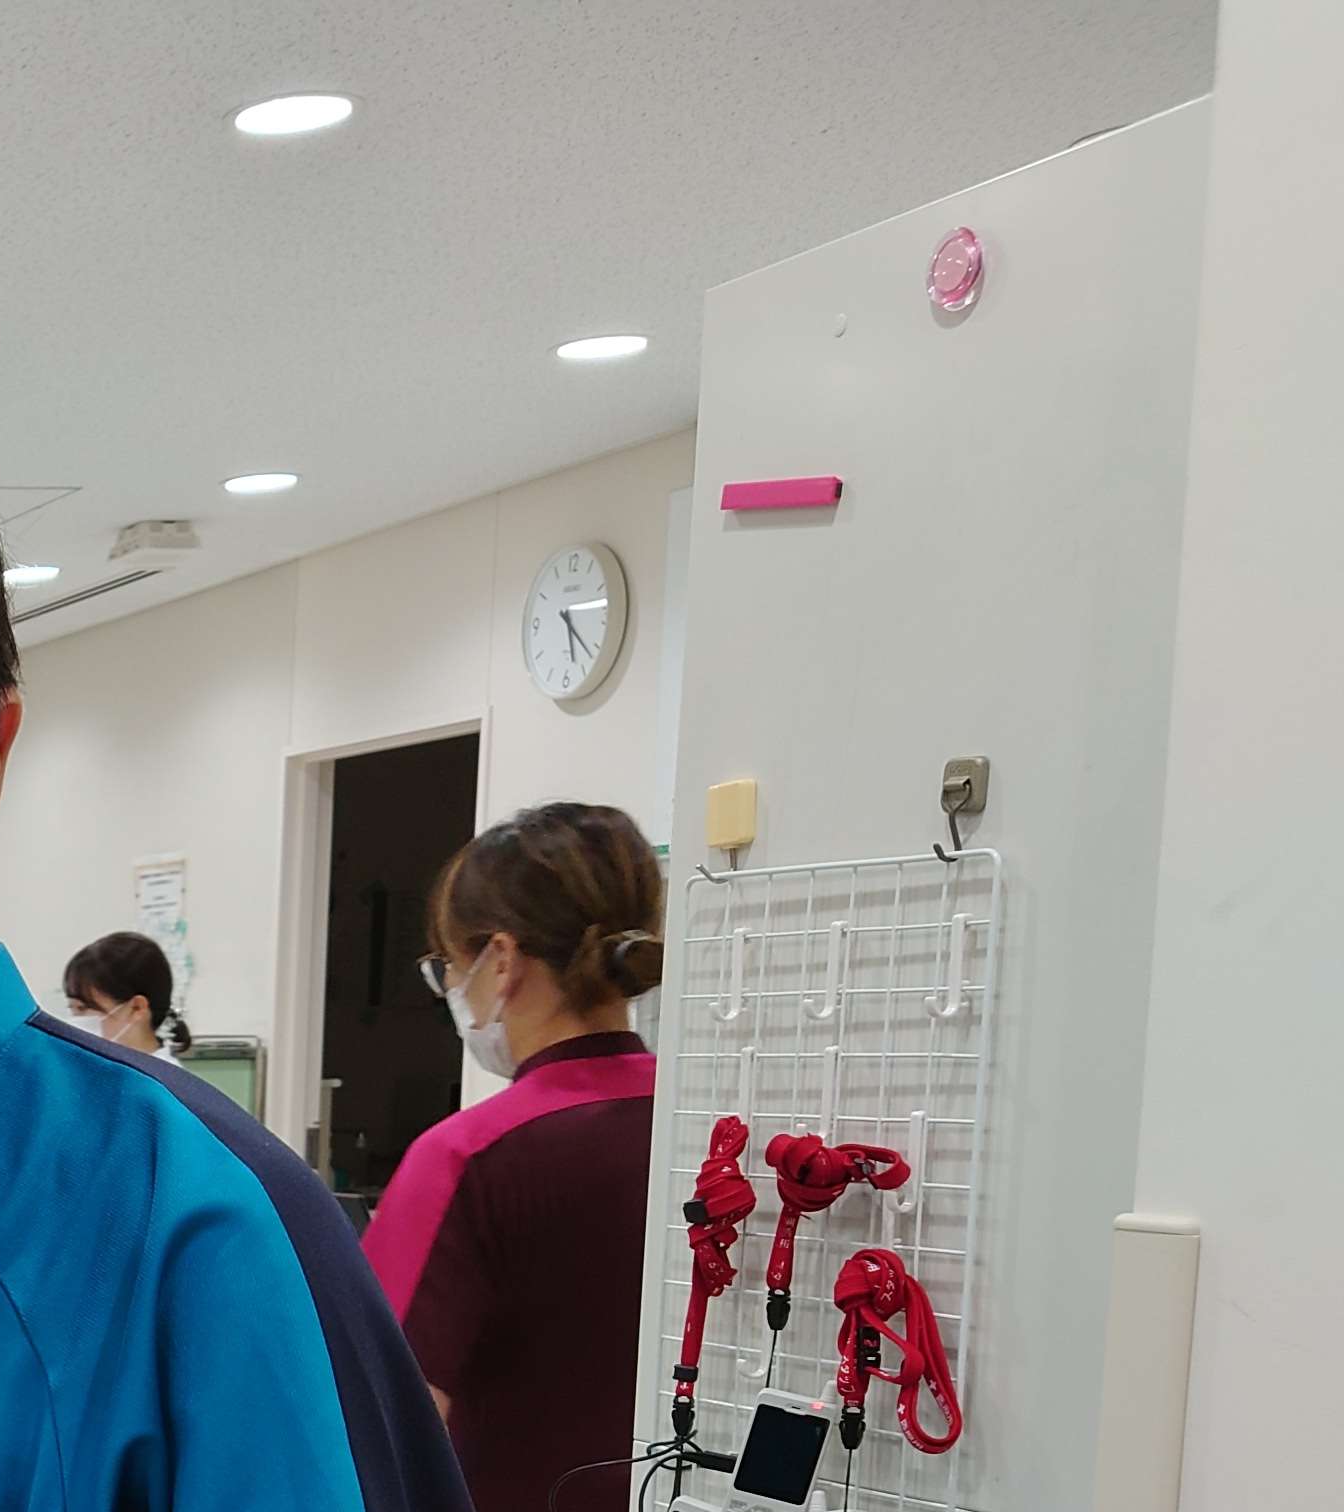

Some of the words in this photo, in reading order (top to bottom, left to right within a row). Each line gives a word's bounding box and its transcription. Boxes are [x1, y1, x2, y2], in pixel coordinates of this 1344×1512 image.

[568, 552, 580, 573] 12
[532, 616, 541, 637] 9
[562, 669, 571, 689] 6
